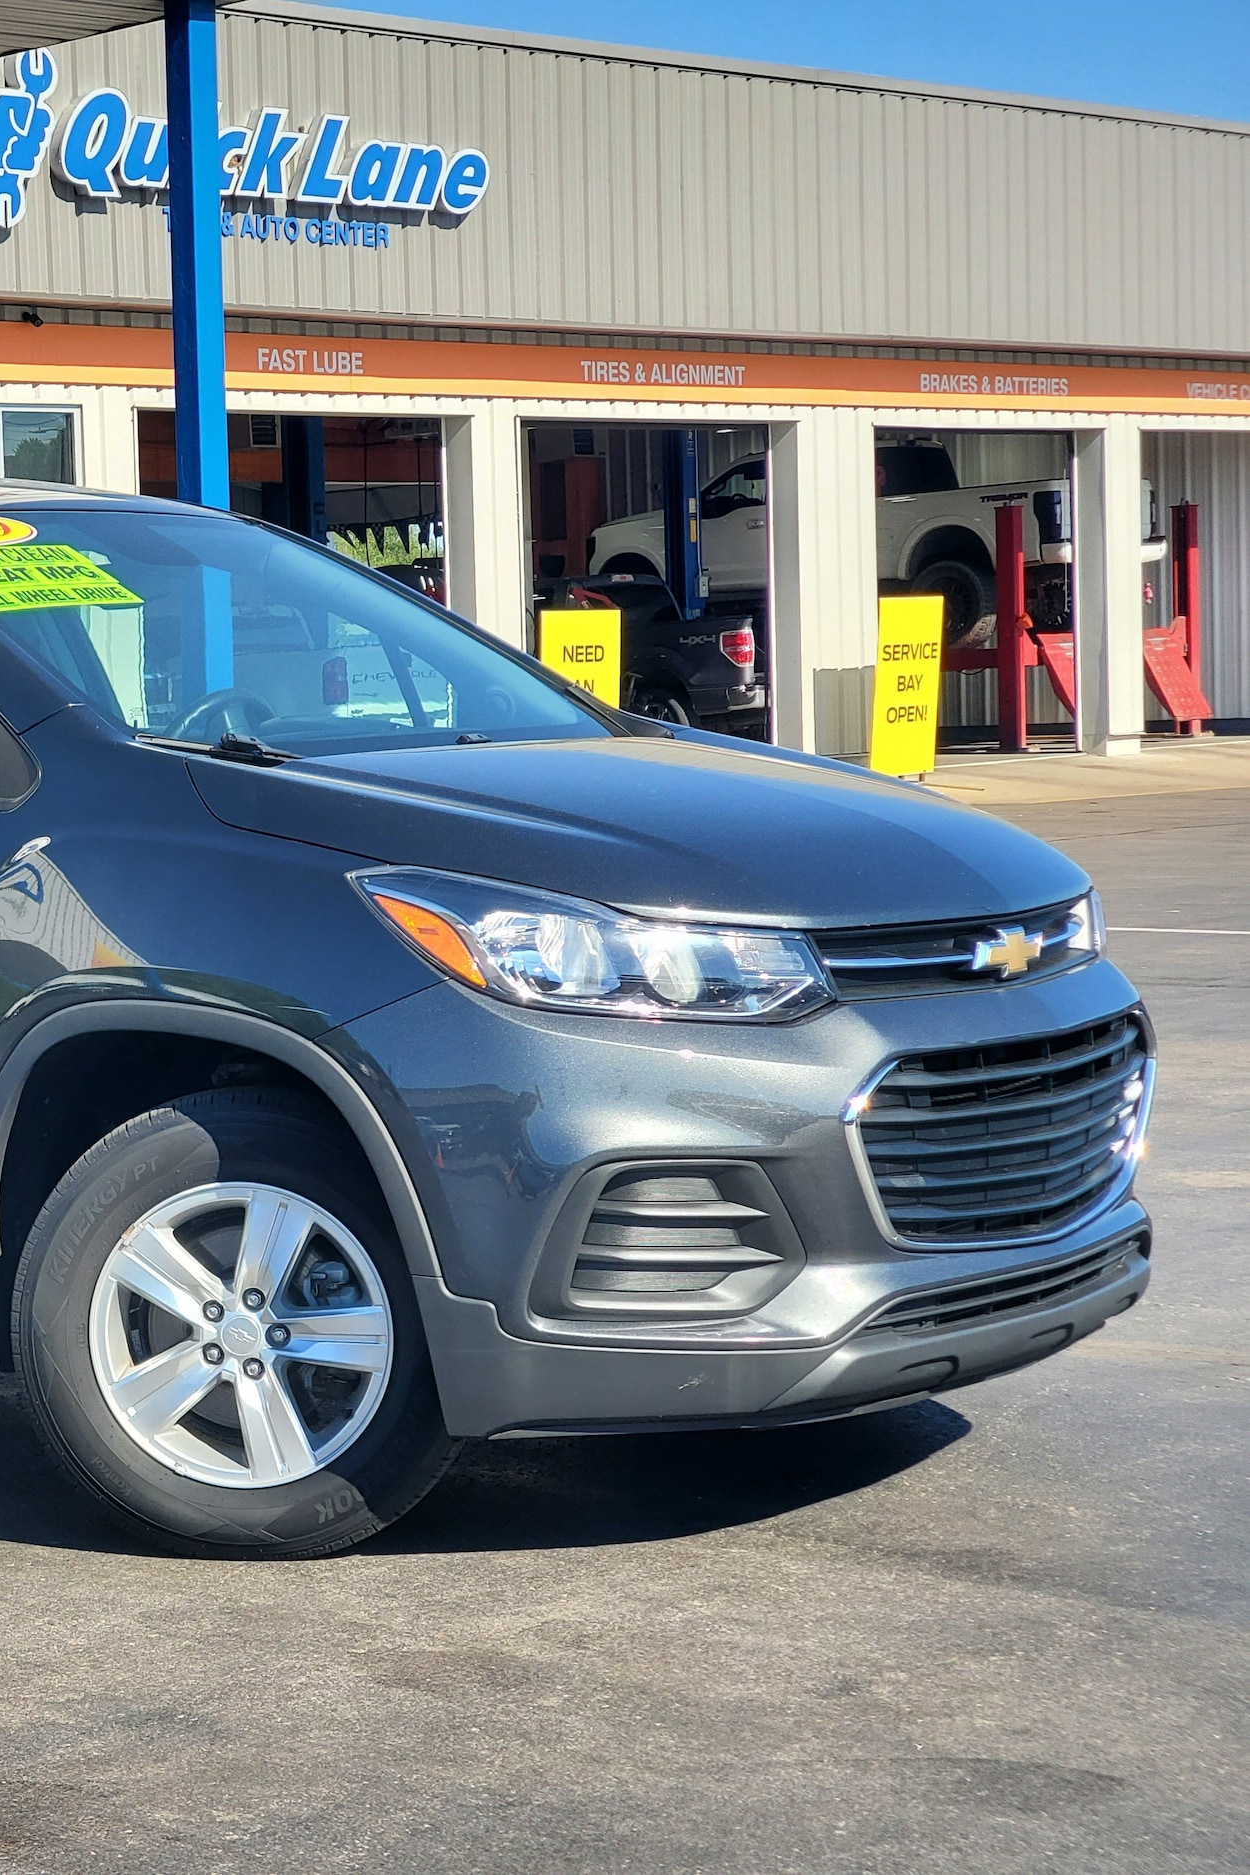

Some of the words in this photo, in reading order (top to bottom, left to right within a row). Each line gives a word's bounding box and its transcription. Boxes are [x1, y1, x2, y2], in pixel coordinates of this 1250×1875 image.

[61, 87, 309, 198] Quck
[298, 114, 490, 214] Lane
[221, 213, 234, 237] &
[241, 216, 300, 242] AUTO
[305, 219, 390, 248] CENTER
[257, 348, 307, 372] FAST
[313, 351, 364, 374] LUBE
[581, 361, 630, 383] TIRES
[635, 363, 646, 383] &
[650, 363, 745, 386] ALIGNMENT
[920, 373, 978, 394] BRAKES
[981, 376, 991, 394] &
[995, 376, 1069, 396] BATTERIES
[1186, 382, 1238, 400] VEHICLE
[1, 546, 74, 564] CLEAN
[38, 563, 99, 581] MPG
[12, 588, 75, 605] WHEEL
[70, 585, 129, 601] DRIVE
[562, 645, 605, 663] NEED
[882, 642, 939, 662] SERVICE
[897, 674, 924, 692] BAY
[886, 704, 929, 724] OPEN!
[134, 1155, 159, 1181] PT
